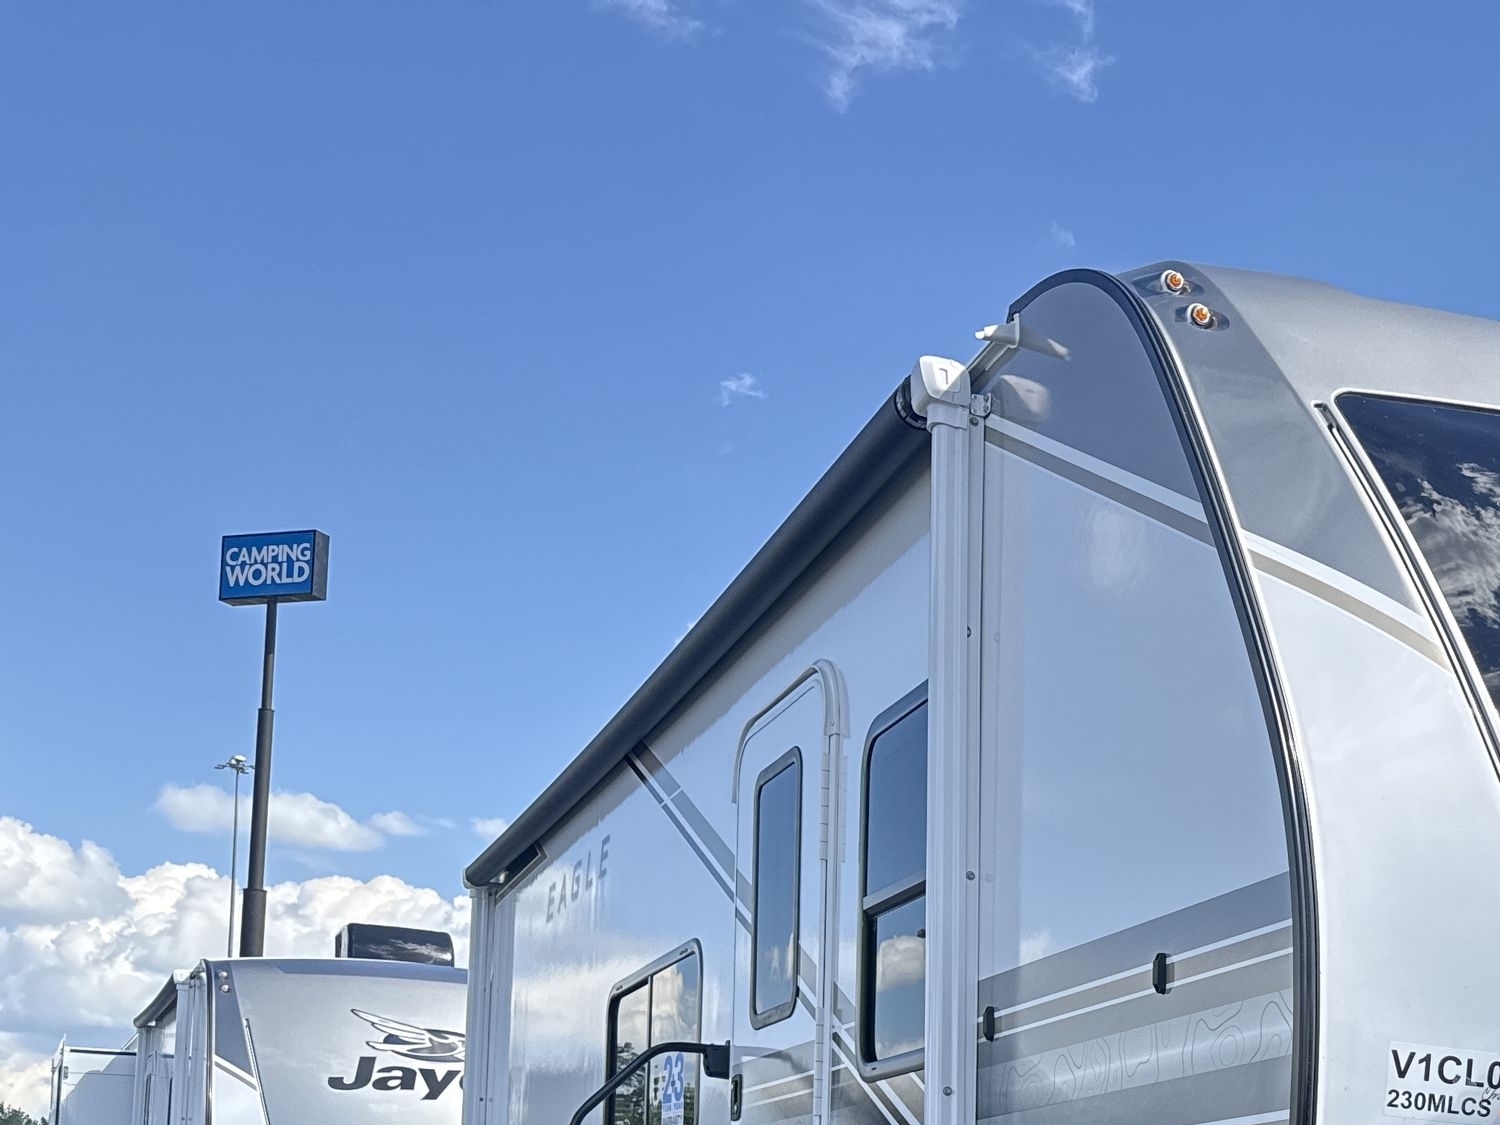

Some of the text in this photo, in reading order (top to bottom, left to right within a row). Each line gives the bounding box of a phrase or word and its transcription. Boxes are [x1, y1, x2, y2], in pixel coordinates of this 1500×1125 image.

[226, 543, 311, 566] CAMPING
[225, 561, 310, 587] WORLD
[546, 834, 611, 924] EAGLE
[327, 1056, 464, 1100] Jay
[1386, 1089, 1492, 1118] 230MLCS
